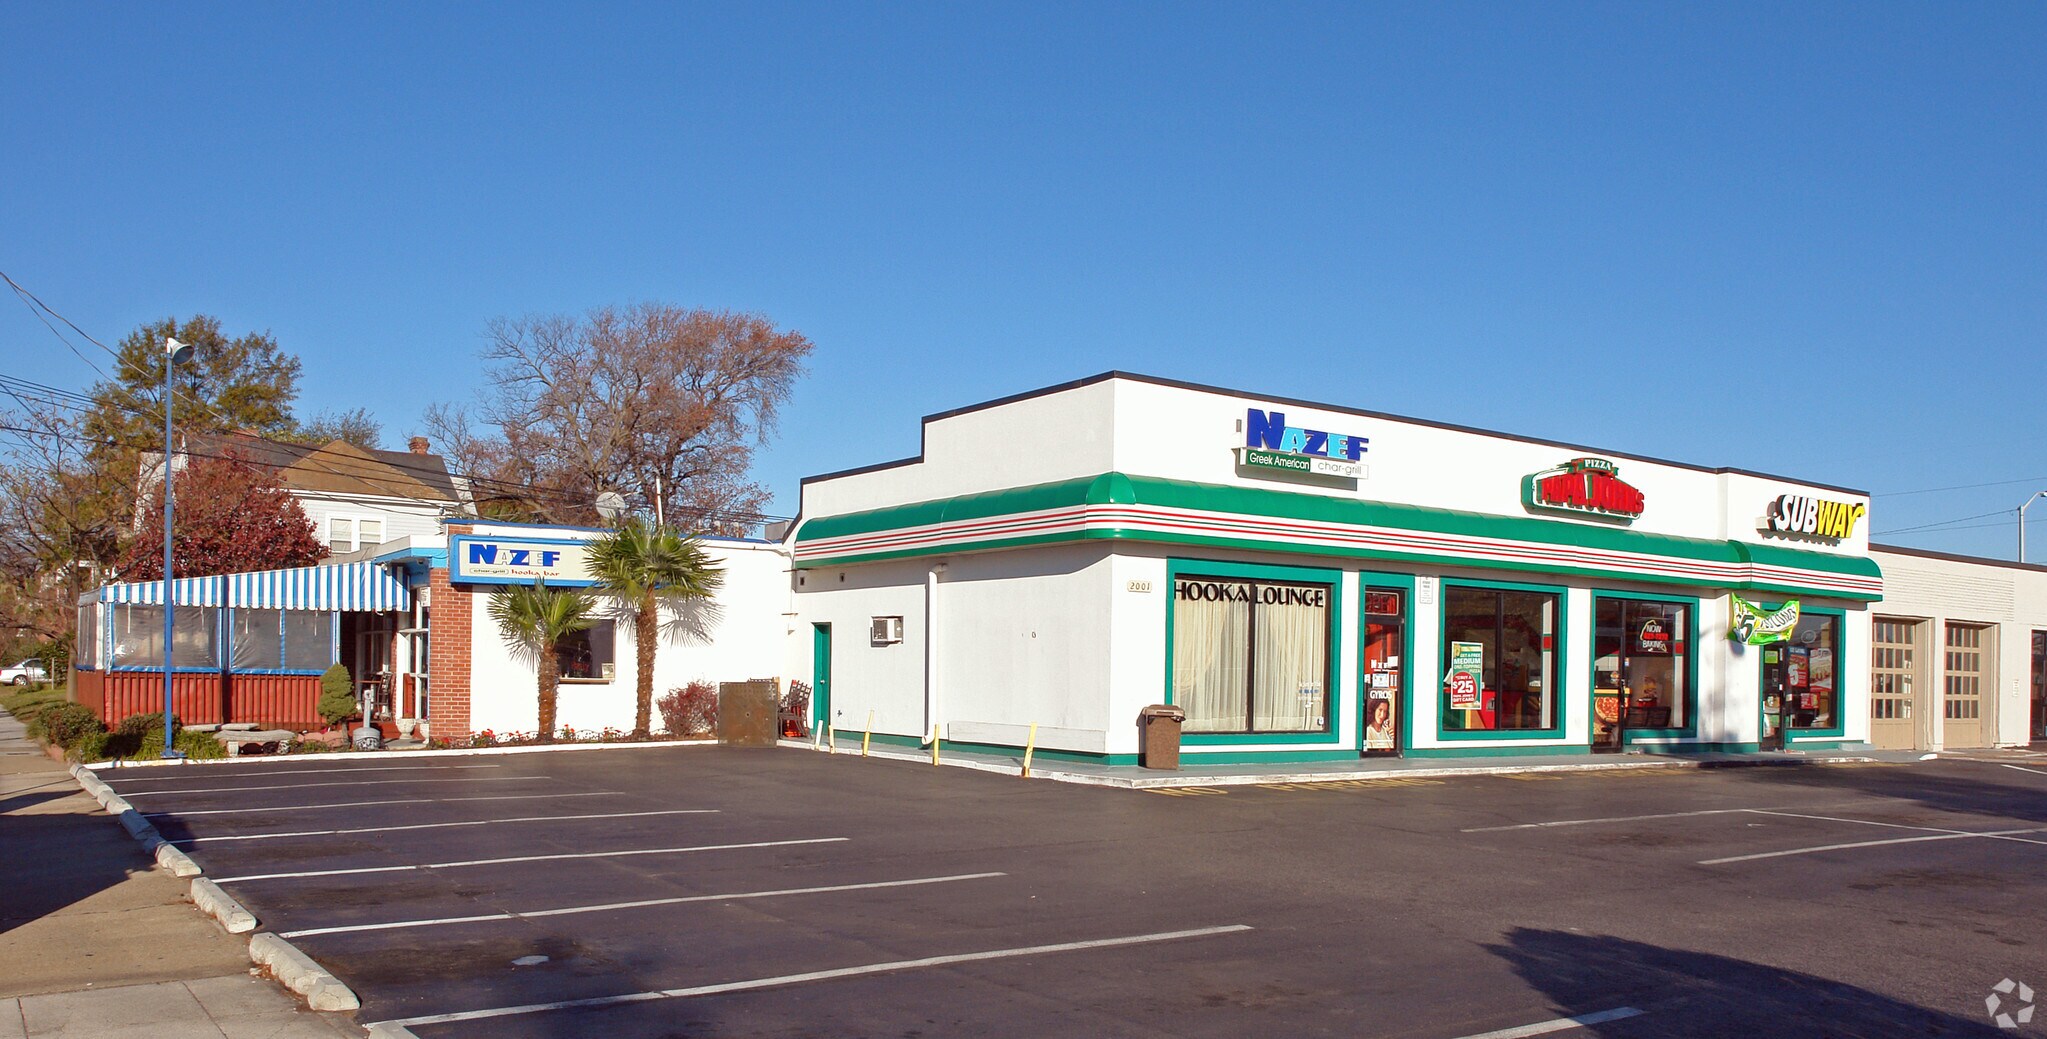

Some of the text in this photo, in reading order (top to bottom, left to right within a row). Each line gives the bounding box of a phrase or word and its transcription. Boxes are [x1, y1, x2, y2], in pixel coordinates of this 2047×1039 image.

[1247, 408, 1369, 461] NAZEF
[1249, 452, 1310, 470] Greek American
[1317, 462, 1362, 475] char-grill
[1584, 459, 1612, 471] PIZZA
[1537, 473, 1588, 507] PAPA
[1774, 495, 1866, 538] SUBWAY
[469, 543, 561, 567] NAZEF
[1129, 581, 1151, 591] 2001
[1174, 580, 1324, 608] HOOKA LOUNGE
[1370, 690, 1393, 700] GYROS
[1453, 680, 1474, 694] $25
